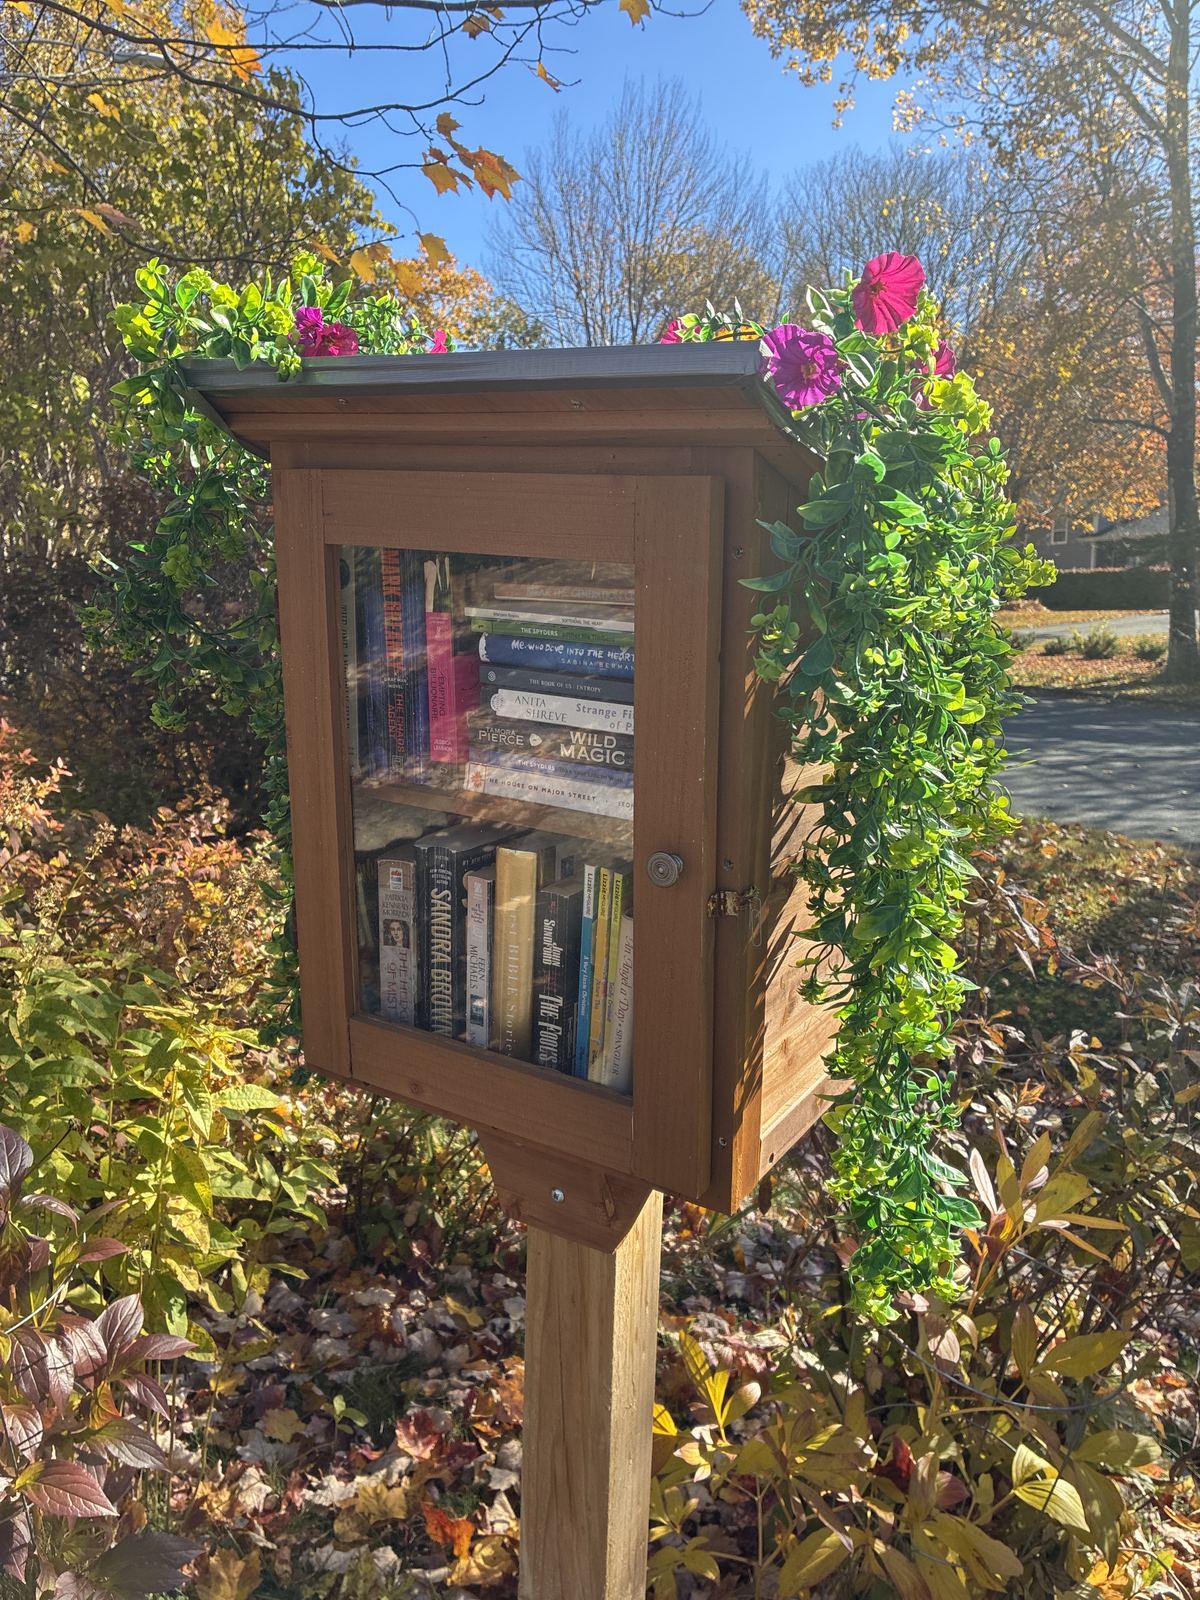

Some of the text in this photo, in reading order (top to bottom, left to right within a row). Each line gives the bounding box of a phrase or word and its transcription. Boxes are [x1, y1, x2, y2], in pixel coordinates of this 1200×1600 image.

[382, 547, 401, 596] MARK
[521, 627, 558, 637] THE SPYDERS
[561, 658, 594, 667] SABINA
[566, 647, 585, 656] INTO
[430, 668, 439, 721] BILLIONAIRE
[514, 695, 546, 708] ANITA
[388, 704, 396, 738] AGENT
[526, 708, 568, 723] SHREVE
[576, 702, 617, 719] Strange
[485, 726, 516, 736] TAMORA
[609, 720, 621, 730] of
[478, 730, 525, 747] PIERCE
[569, 731, 617, 749] WILD
[560, 743, 626, 766] MAGIC
[527, 784, 539, 792] ON
[541, 787, 566, 797] MAJOR
[567, 791, 597, 802] STREET
[617, 800, 634, 809] LEO
[431, 887, 452, 963] SANDRA
[542, 918, 556, 966] SANDFORD
[552, 941, 564, 968] JOHN
[469, 944, 479, 990] MICHAELS
[619, 955, 633, 989] Angel
[387, 962, 398, 1009] OF MIST
[431, 968, 453, 1038] BROWN
[538, 994, 564, 1020] THE
[614, 997, 630, 1023] Day
[611, 1028, 624, 1076] SPANGLER
